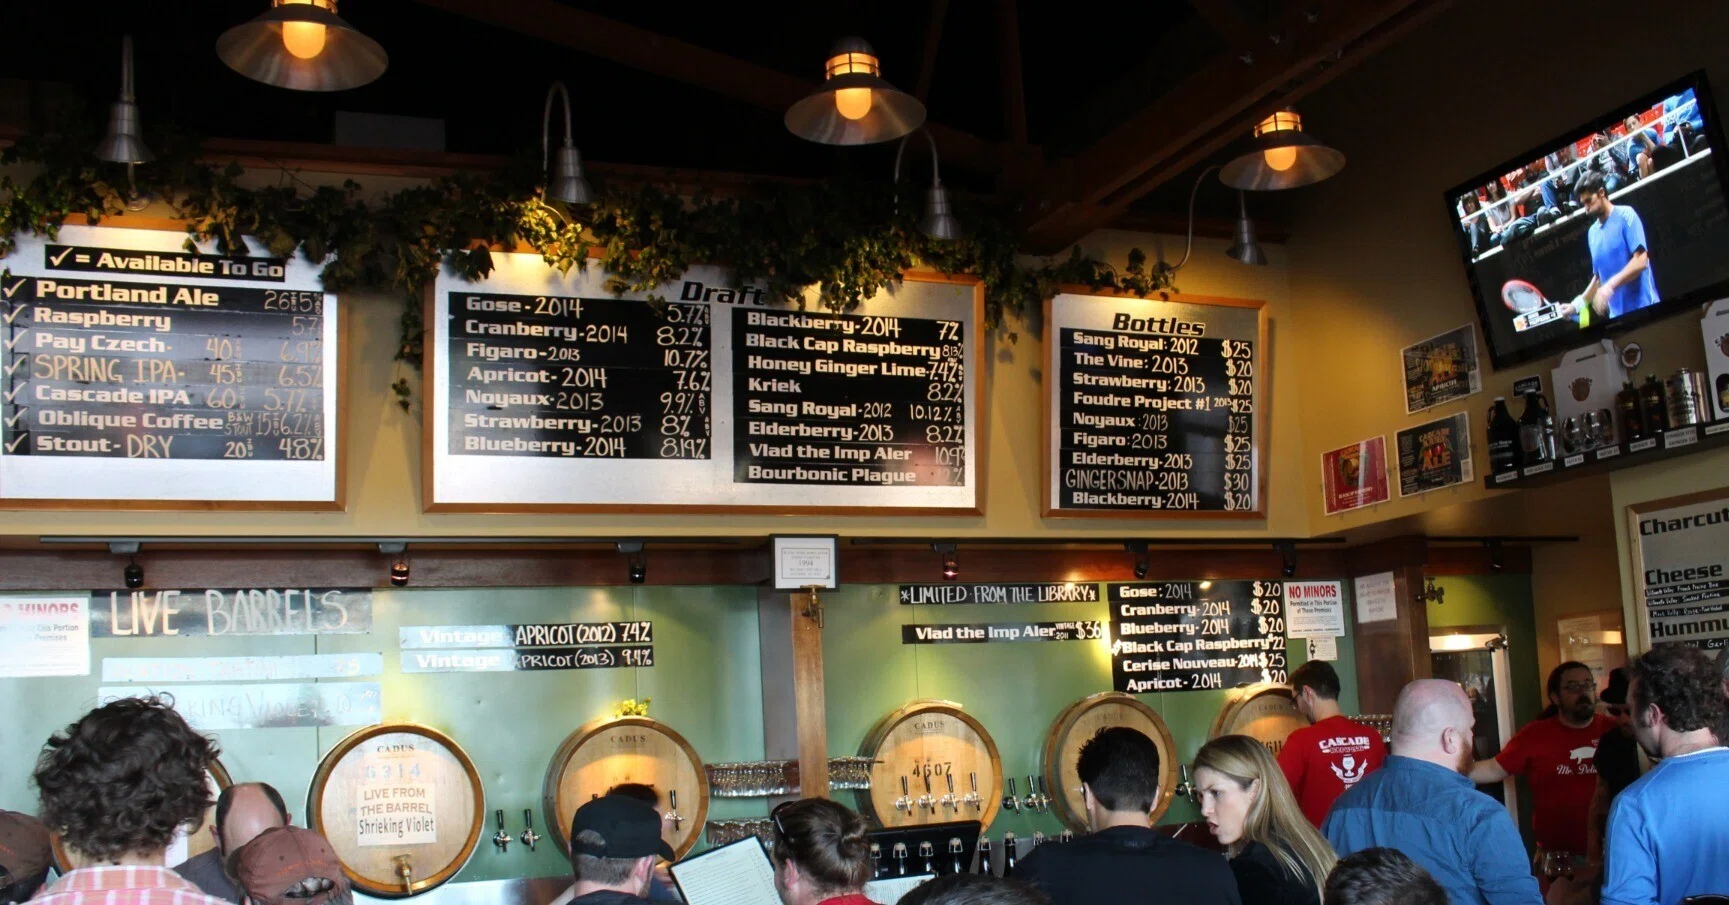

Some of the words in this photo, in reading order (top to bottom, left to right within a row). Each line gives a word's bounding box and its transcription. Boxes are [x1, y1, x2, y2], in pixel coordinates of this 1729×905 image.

[96, 252, 214, 274] Available
[219, 260, 246, 275] To
[252, 263, 283, 277] Go
[36, 280, 169, 304] Portland
[173, 288, 219, 306] Ale
[680, 281, 766, 305] Draft
[33, 308, 171, 332] Raspberry
[1113, 313, 1205, 336] Bottles
[657, 326, 703, 347] 8.2%
[936, 321, 959, 341] 7%
[34, 333, 85, 352] Pay
[207, 338, 232, 359] 40
[746, 333, 800, 347] Black
[804, 337, 839, 354] Cap
[843, 339, 940, 359] Raspberry
[1073, 332, 1115, 349] Sang
[1170, 338, 1199, 355] 2012
[1221, 340, 1251, 359] $25
[664, 349, 708, 368] 10.7%
[748, 355, 811, 374] Honey
[815, 358, 878, 376] Ginger
[1074, 353, 1104, 365] The
[1152, 355, 1188, 374] 2013
[1226, 359, 1252, 377] $20
[34, 354, 123, 383] SPRING
[209, 363, 236, 384] 45
[673, 371, 710, 392] 7.6%
[748, 378, 801, 393] Kriek
[927, 383, 963, 403] 8.2%
[1174, 376, 1205, 393] 2013
[1229, 378, 1252, 395] $20
[35, 385, 143, 403] Cascade
[149, 389, 190, 405] IPA
[207, 387, 236, 408] 60
[1074, 392, 1131, 407] Foudre
[1135, 395, 1192, 411] Project
[1195, 396, 1211, 411] #1
[1231, 399, 1252, 413] $25
[748, 400, 798, 416] Sang
[38, 410, 136, 432] Oblique
[142, 413, 224, 431] Coffee
[661, 415, 690, 437] 8%
[1143, 414, 1168, 431] 2013
[1228, 415, 1248, 433] $25
[926, 425, 963, 443] 8.2%
[1132, 433, 1167, 449] 2013
[1224, 434, 1251, 453] $25
[127, 433, 174, 459] DRY
[224, 442, 246, 458] 20
[661, 438, 706, 459] 8.19%
[750, 443, 792, 458] Vlad
[796, 445, 831, 459] the
[834, 446, 870, 462] Imp
[874, 447, 912, 460] Aler
[1225, 454, 1251, 470] $25
[748, 465, 848, 481] Bourbonic
[852, 469, 916, 485] Plague
[1224, 473, 1249, 491] $30
[1224, 491, 1251, 511] $20
[1645, 564, 1722, 586] Cheese
[974, 585, 1007, 603] FROM
[1011, 586, 1034, 602] THE
[1165, 583, 1192, 599] 2014
[1253, 581, 1281, 597] $20
[1289, 586, 1301, 598] NO
[1304, 585, 1337, 598] MINORS
[18, 603, 79, 615] MINORS
[110, 591, 181, 636] LIVE
[205, 589, 348, 635] BARRELS
[1251, 598, 1279, 615] $20
[915, 627, 953, 640] Vlad
[955, 627, 984, 639] the
[988, 626, 1019, 640] Imp
[1076, 620, 1101, 640] $36
[1258, 616, 1283, 634] $20
[419, 627, 502, 645] Vintage
[1123, 641, 1163, 653] Black
[1167, 641, 1193, 655] Cap
[1196, 636, 1270, 652] Raspberry
[417, 654, 500, 669] Vintage
[1123, 658, 1170, 672] Cerise
[1259, 652, 1285, 668] $25
[1261, 668, 1286, 684] $20
[914, 721, 945, 729] CADUS
[377, 745, 415, 753] CADUS
[611, 735, 646, 743] CADUS
[1319, 736, 1370, 750] CASCADE
[364, 789, 389, 801] LIVE
[393, 788, 425, 798] FROM
[361, 804, 383, 816] THE
[387, 803, 432, 815] BARREL
[359, 818, 403, 838] Shrieking
[406, 817, 434, 833] Violet
